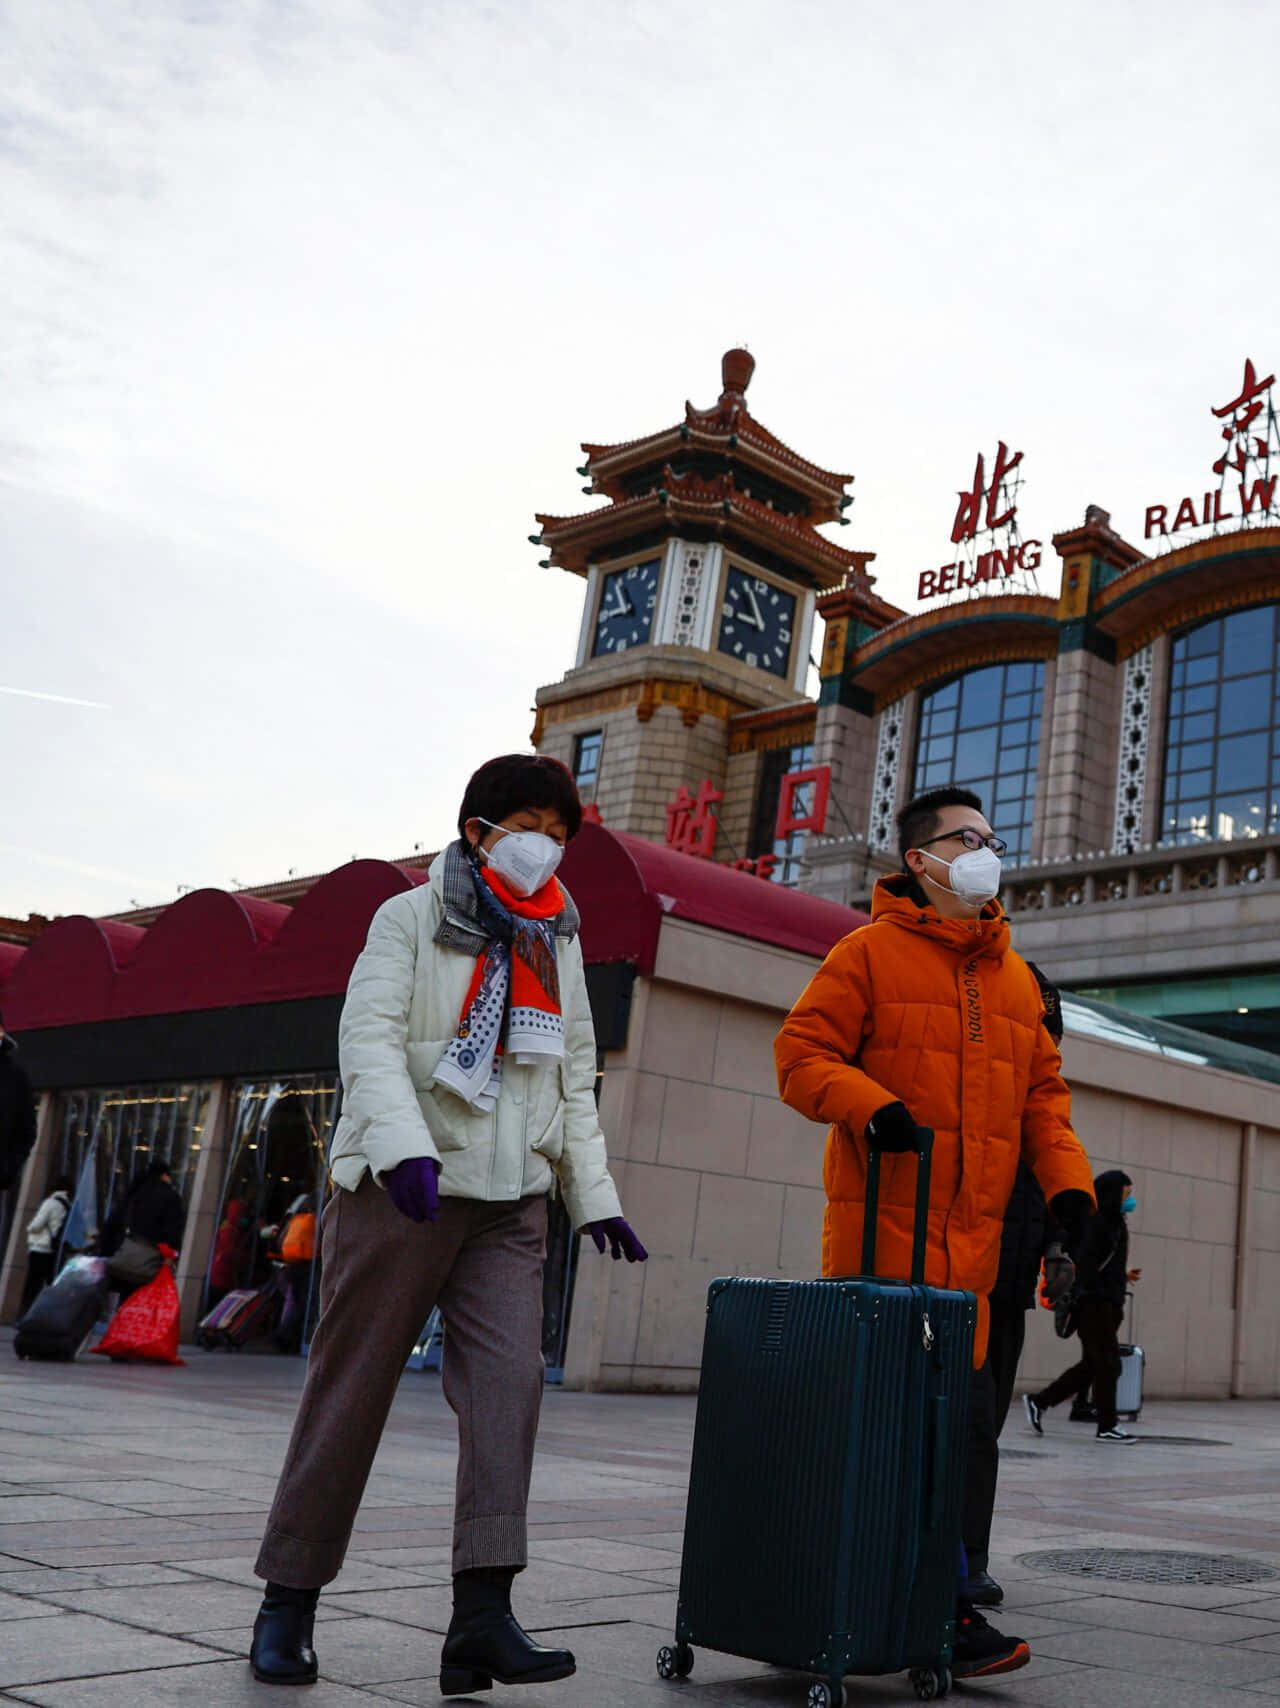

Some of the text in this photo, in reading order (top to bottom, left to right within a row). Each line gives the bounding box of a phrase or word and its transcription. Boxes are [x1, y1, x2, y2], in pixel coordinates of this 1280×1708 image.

[950, 440, 1025, 544] 北
[1211, 357, 1277, 475] 京
[917, 539, 1042, 601] BEIJING
